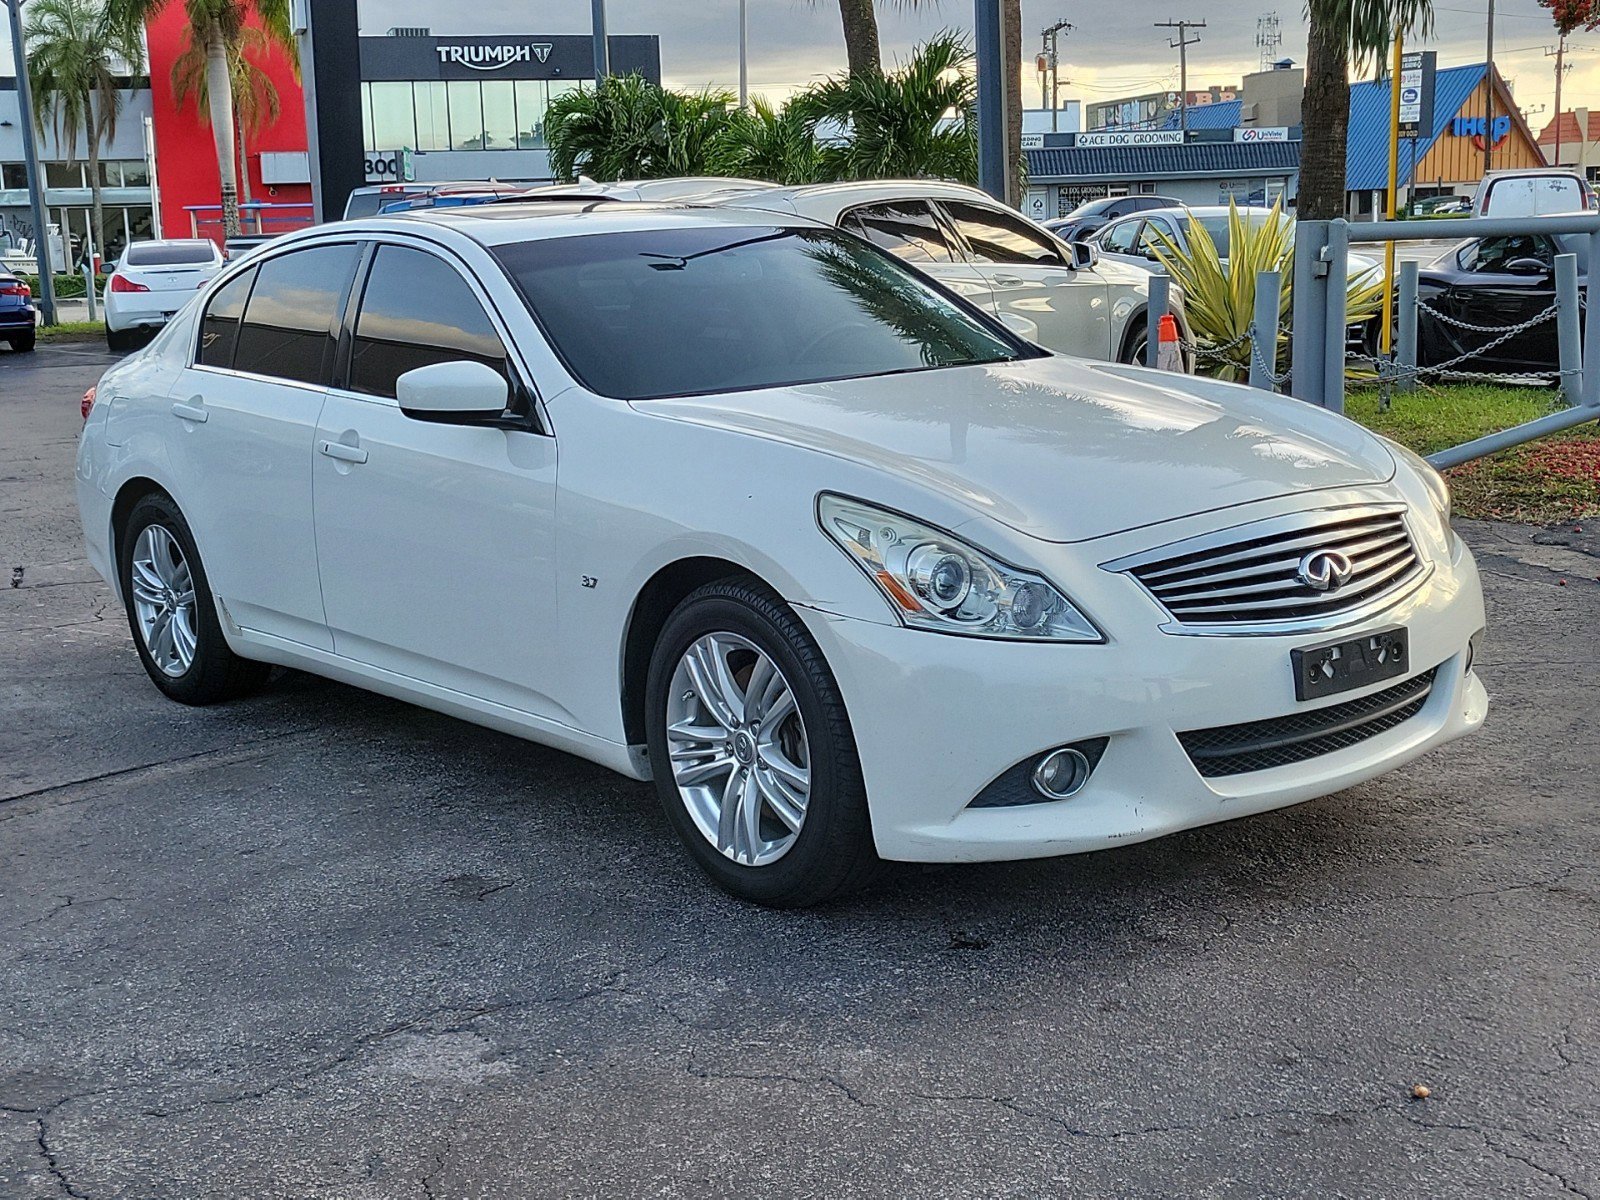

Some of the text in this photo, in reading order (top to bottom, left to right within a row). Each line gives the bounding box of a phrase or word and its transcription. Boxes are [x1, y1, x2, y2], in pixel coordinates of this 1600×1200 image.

[436, 45, 531, 70] TRIUMPH
[1088, 133, 1181, 145] ACE DOG GROOMING
[1081, 186, 1106, 194] GROOMING
[581, 575, 598, 588] 37
